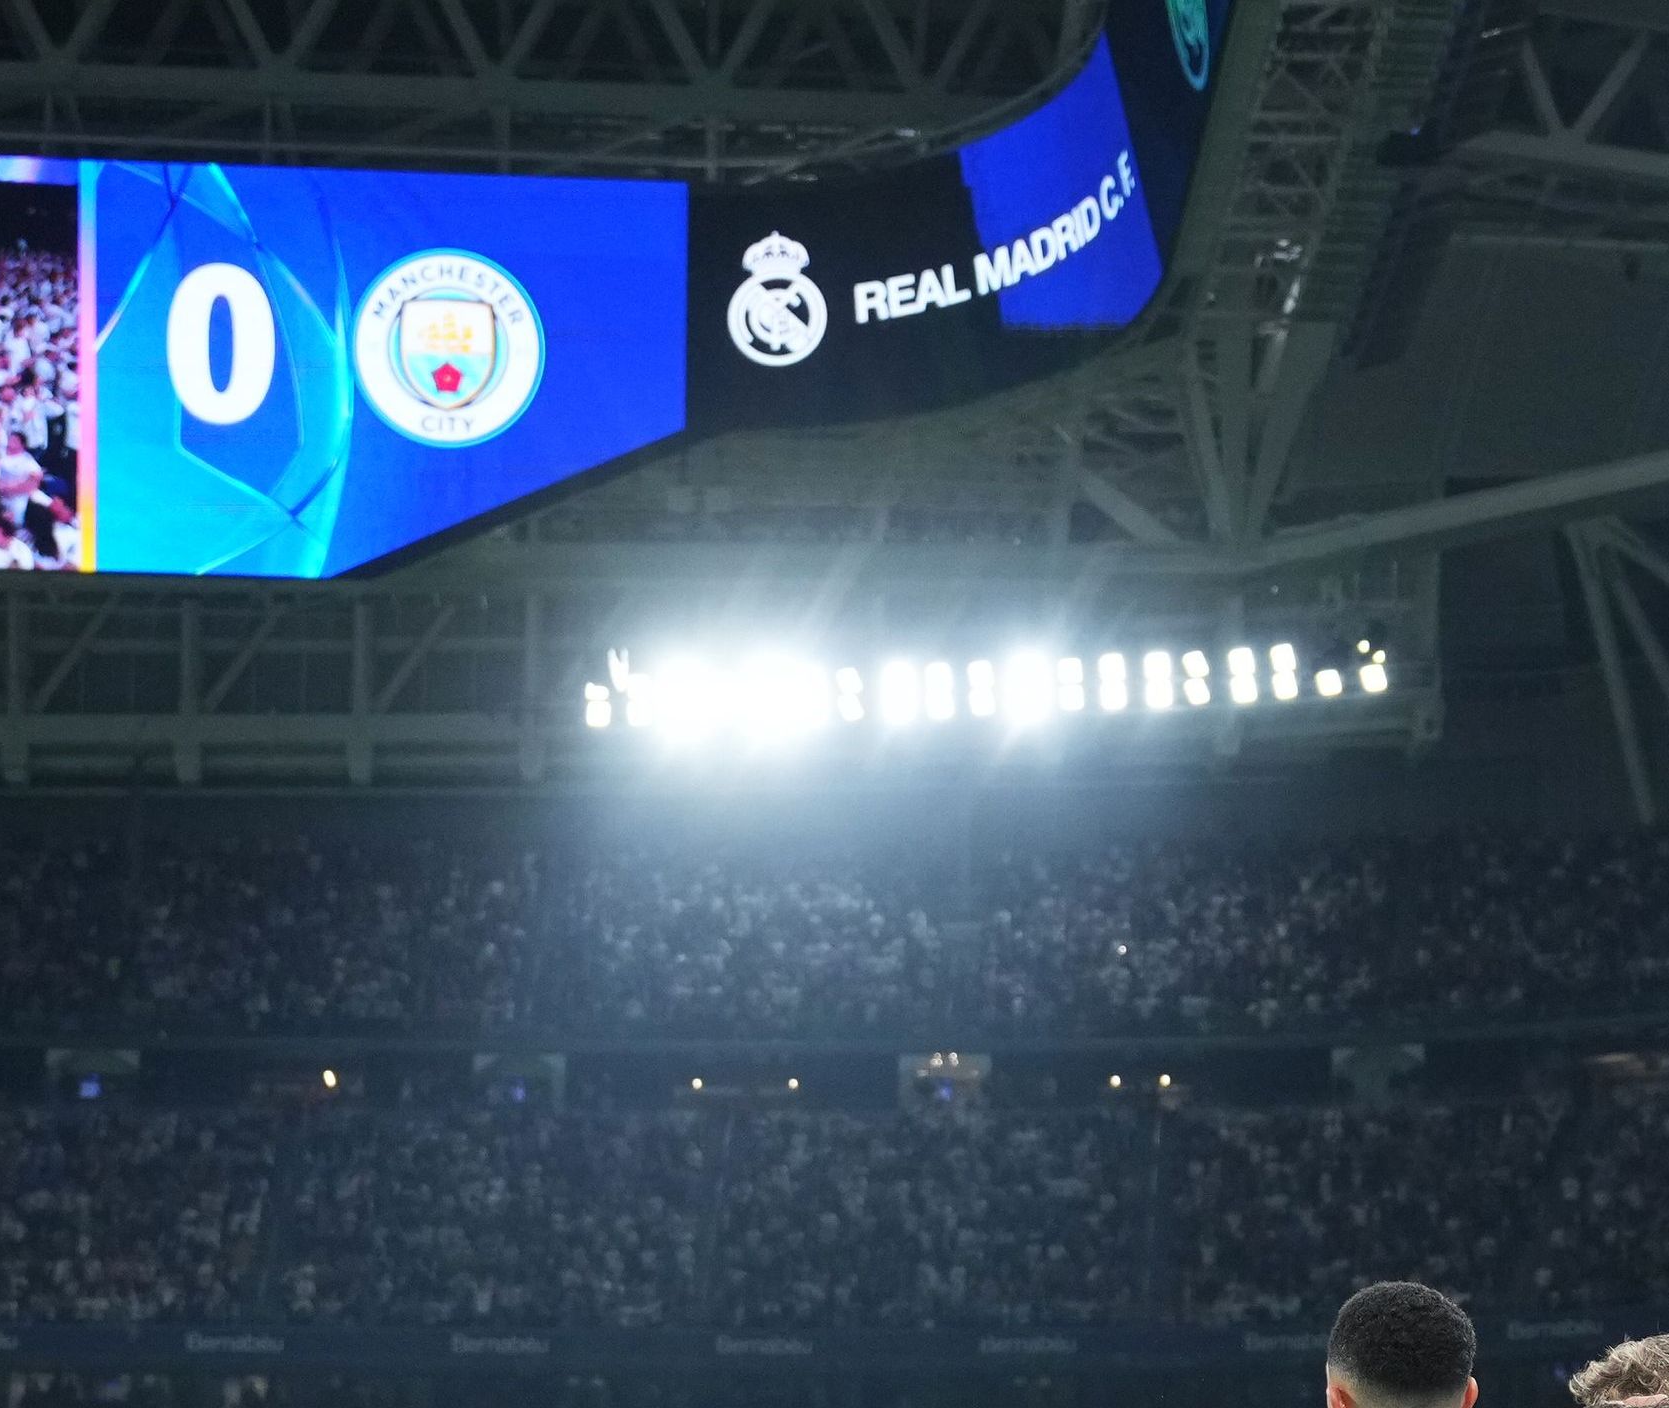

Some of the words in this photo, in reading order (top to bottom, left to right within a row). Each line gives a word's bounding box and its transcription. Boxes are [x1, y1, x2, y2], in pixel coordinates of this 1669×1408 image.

[372, 263, 525, 326] MANCHESTER
[853, 263, 972, 325] REAL
[973, 195, 1101, 296] MADRID
[166, 262, 277, 426] 0
[420, 415, 476, 433] CITY
